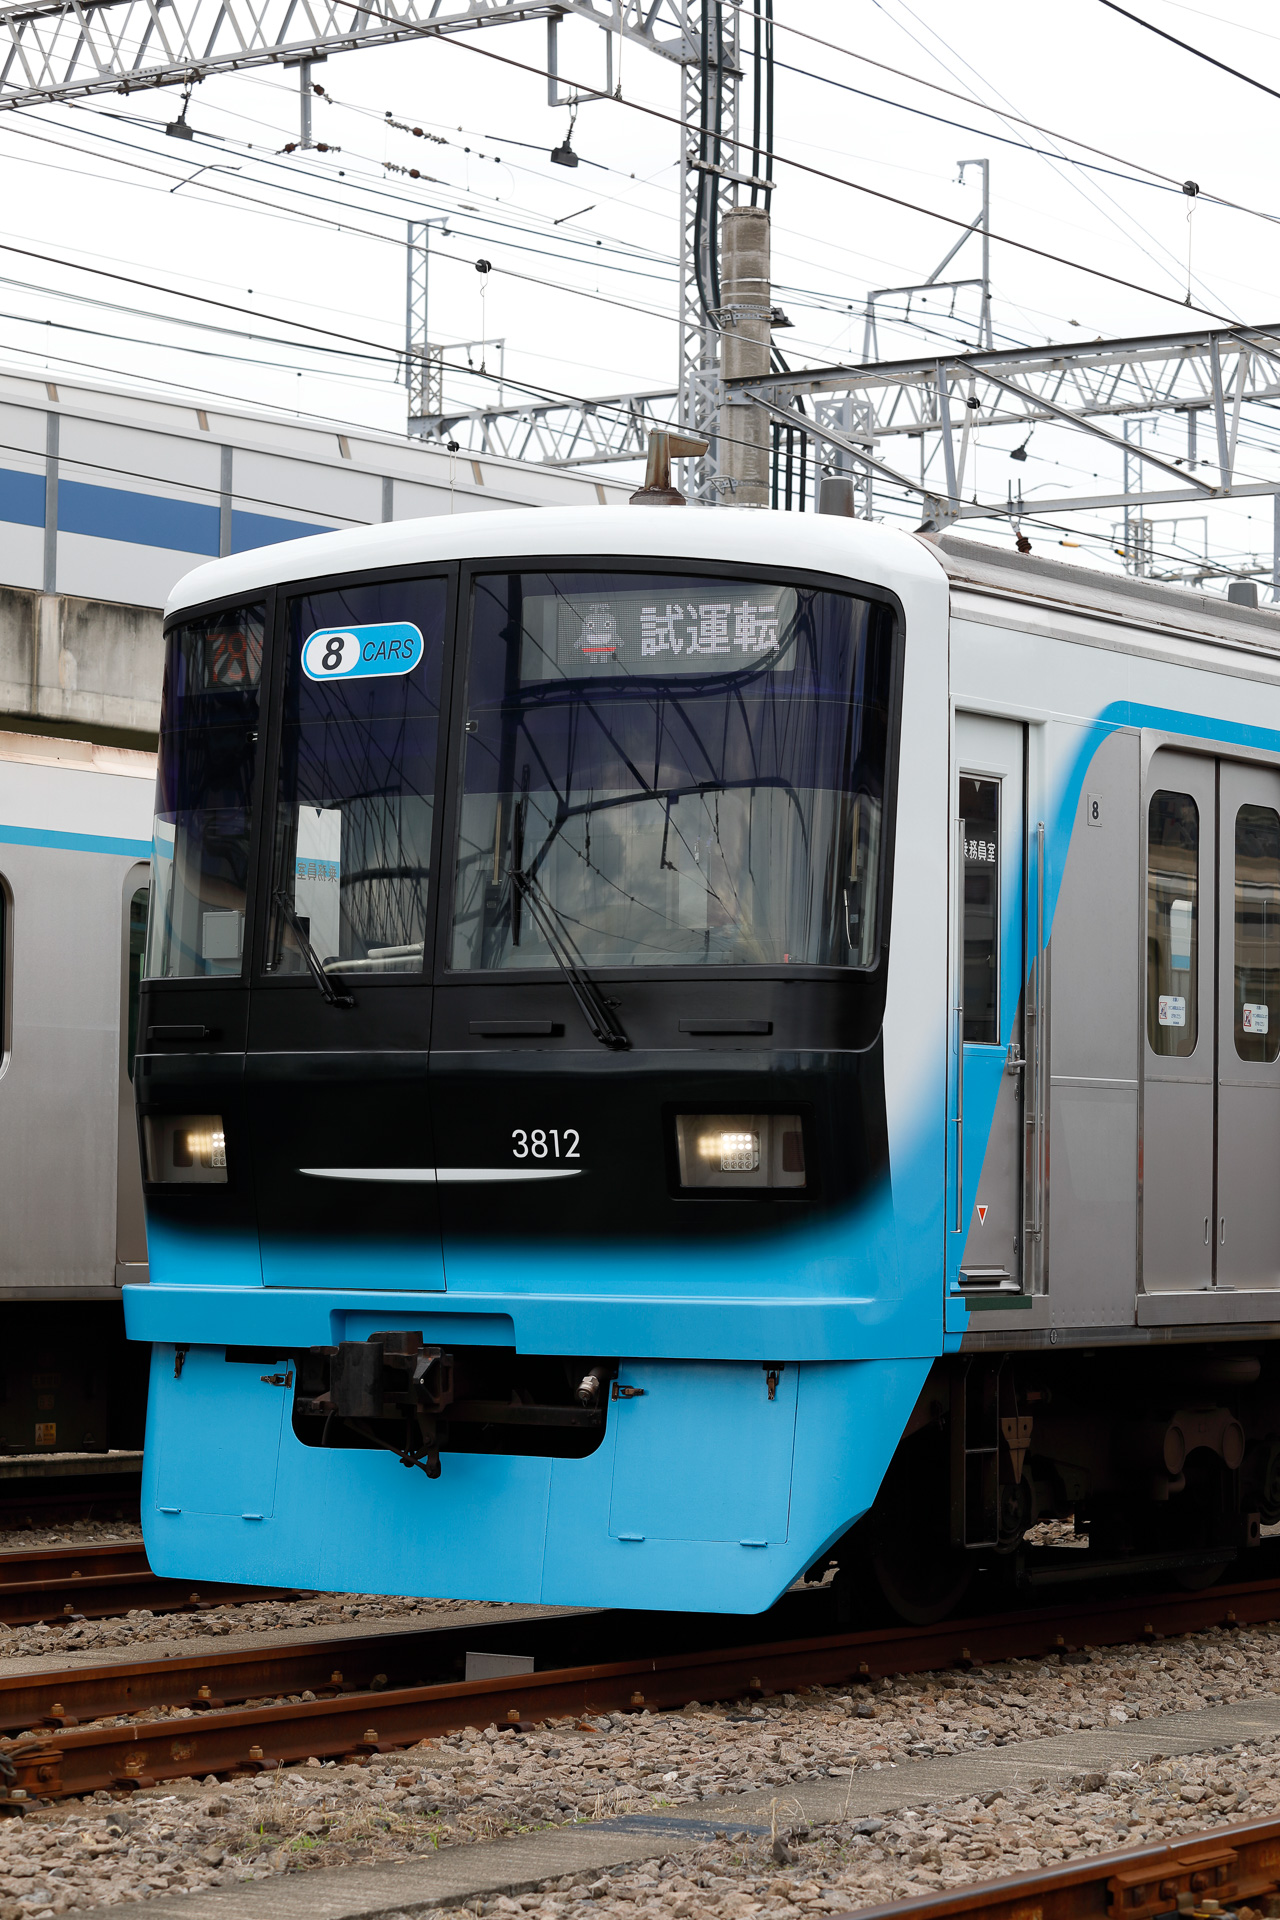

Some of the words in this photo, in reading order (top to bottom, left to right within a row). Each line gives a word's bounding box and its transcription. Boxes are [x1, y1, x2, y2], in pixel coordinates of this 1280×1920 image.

[640, 601, 780, 656] 試運転
[321, 636, 345, 671] 8
[362, 638, 415, 662] CARS
[1092, 800, 1100, 820] 8
[511, 1128, 581, 1159] 3812
